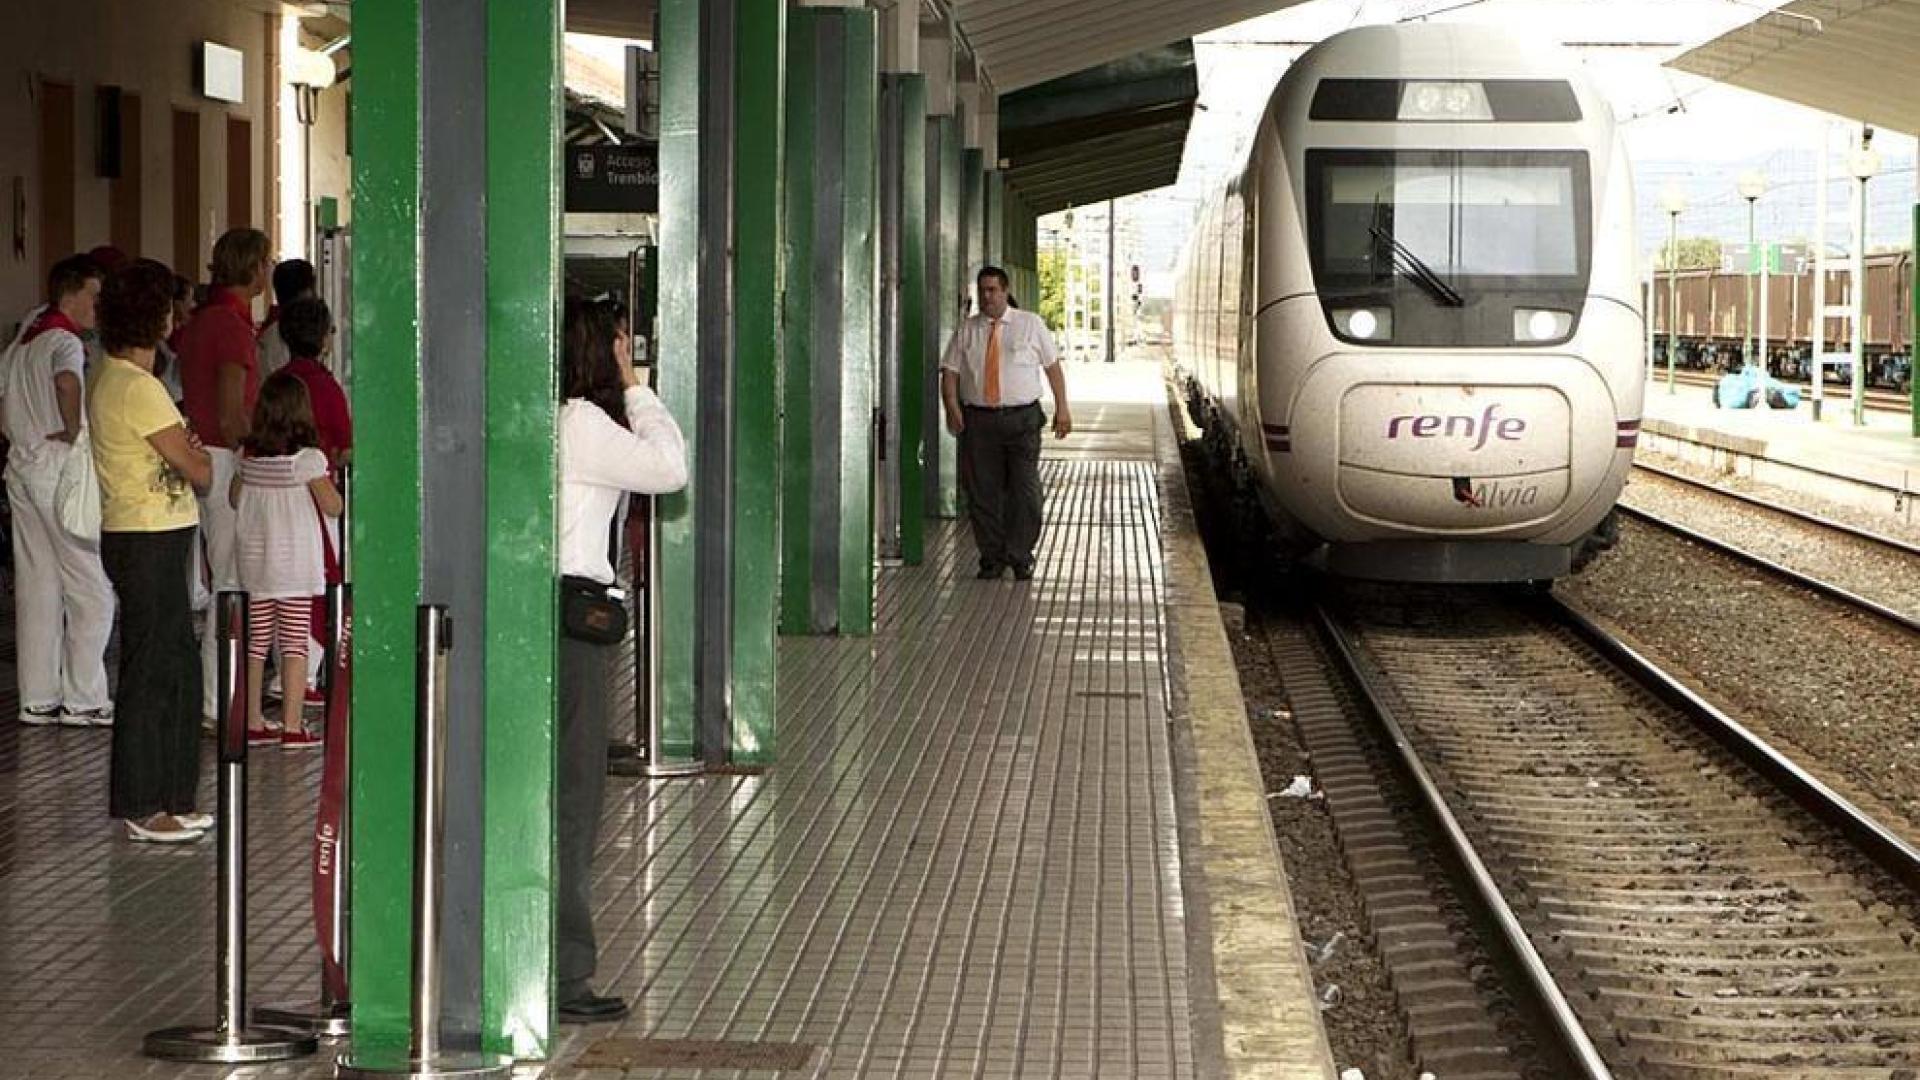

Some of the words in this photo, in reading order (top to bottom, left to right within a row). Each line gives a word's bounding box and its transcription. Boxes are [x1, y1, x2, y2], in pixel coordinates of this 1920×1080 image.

[1387, 403, 1526, 452] renfe
[1473, 480, 1538, 508] Alvia
[317, 823, 334, 875] renfe
